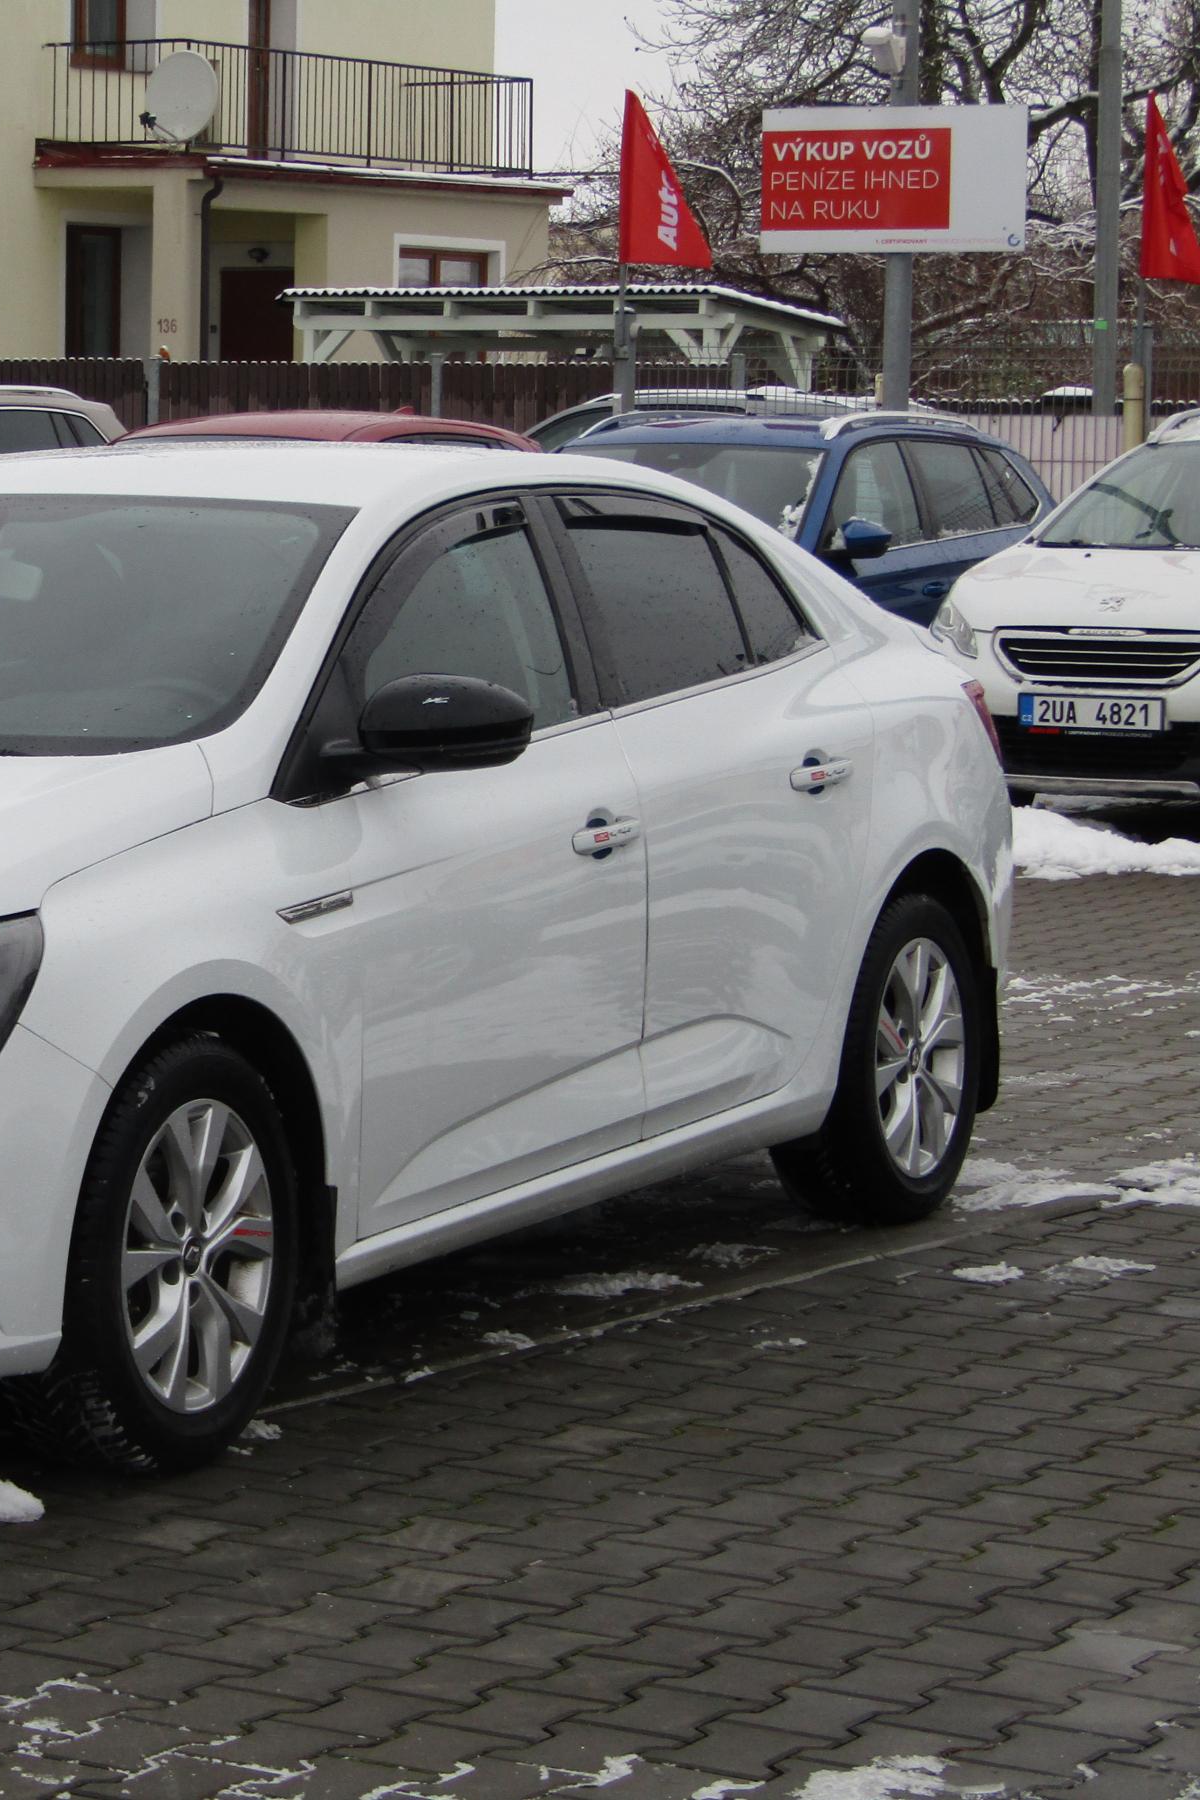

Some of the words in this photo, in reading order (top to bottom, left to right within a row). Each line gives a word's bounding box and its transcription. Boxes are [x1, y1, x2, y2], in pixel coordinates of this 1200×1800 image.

[772, 137, 855, 162] VÝKUP
[862, 134, 932, 161] VOZŮ
[770, 167, 856, 191] PENÍZE
[864, 169, 940, 190] IHNED
[770, 201, 805, 220] NA
[813, 200, 880, 220] RUKU
[157, 318, 177, 334] 136
[1021, 714, 1033, 722] CZ
[1038, 700, 1077, 724] 2UA
[1095, 702, 1149, 727] 4821
